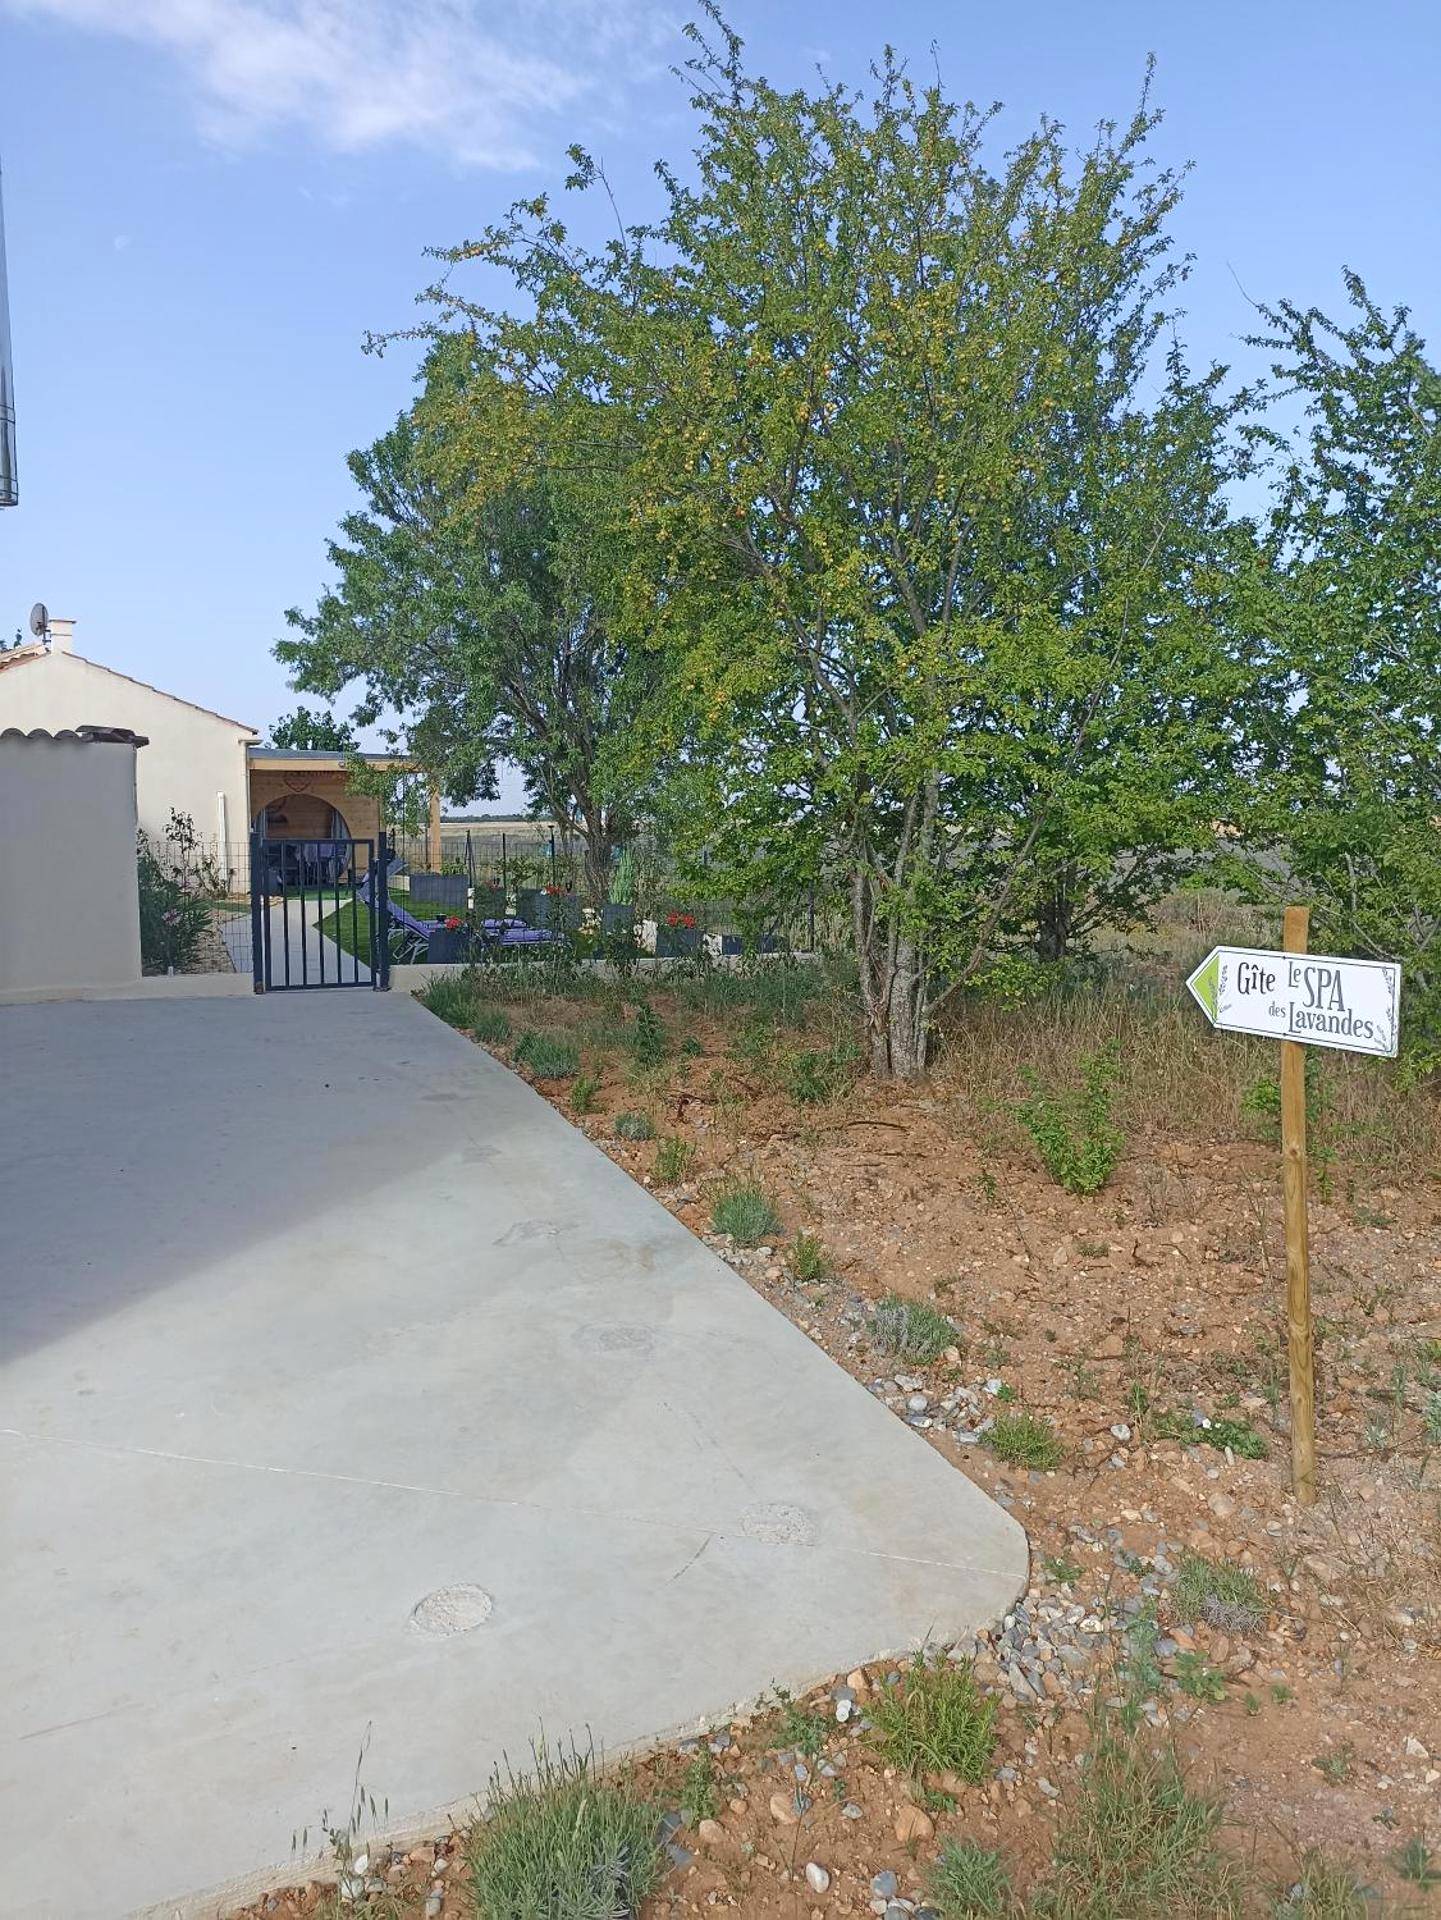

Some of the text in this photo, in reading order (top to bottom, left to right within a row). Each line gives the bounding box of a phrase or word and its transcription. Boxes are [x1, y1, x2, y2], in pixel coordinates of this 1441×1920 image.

[1237, 961, 1346, 1012] Gîte Le SPA
[1268, 1001, 1374, 1039] des Lavandes
